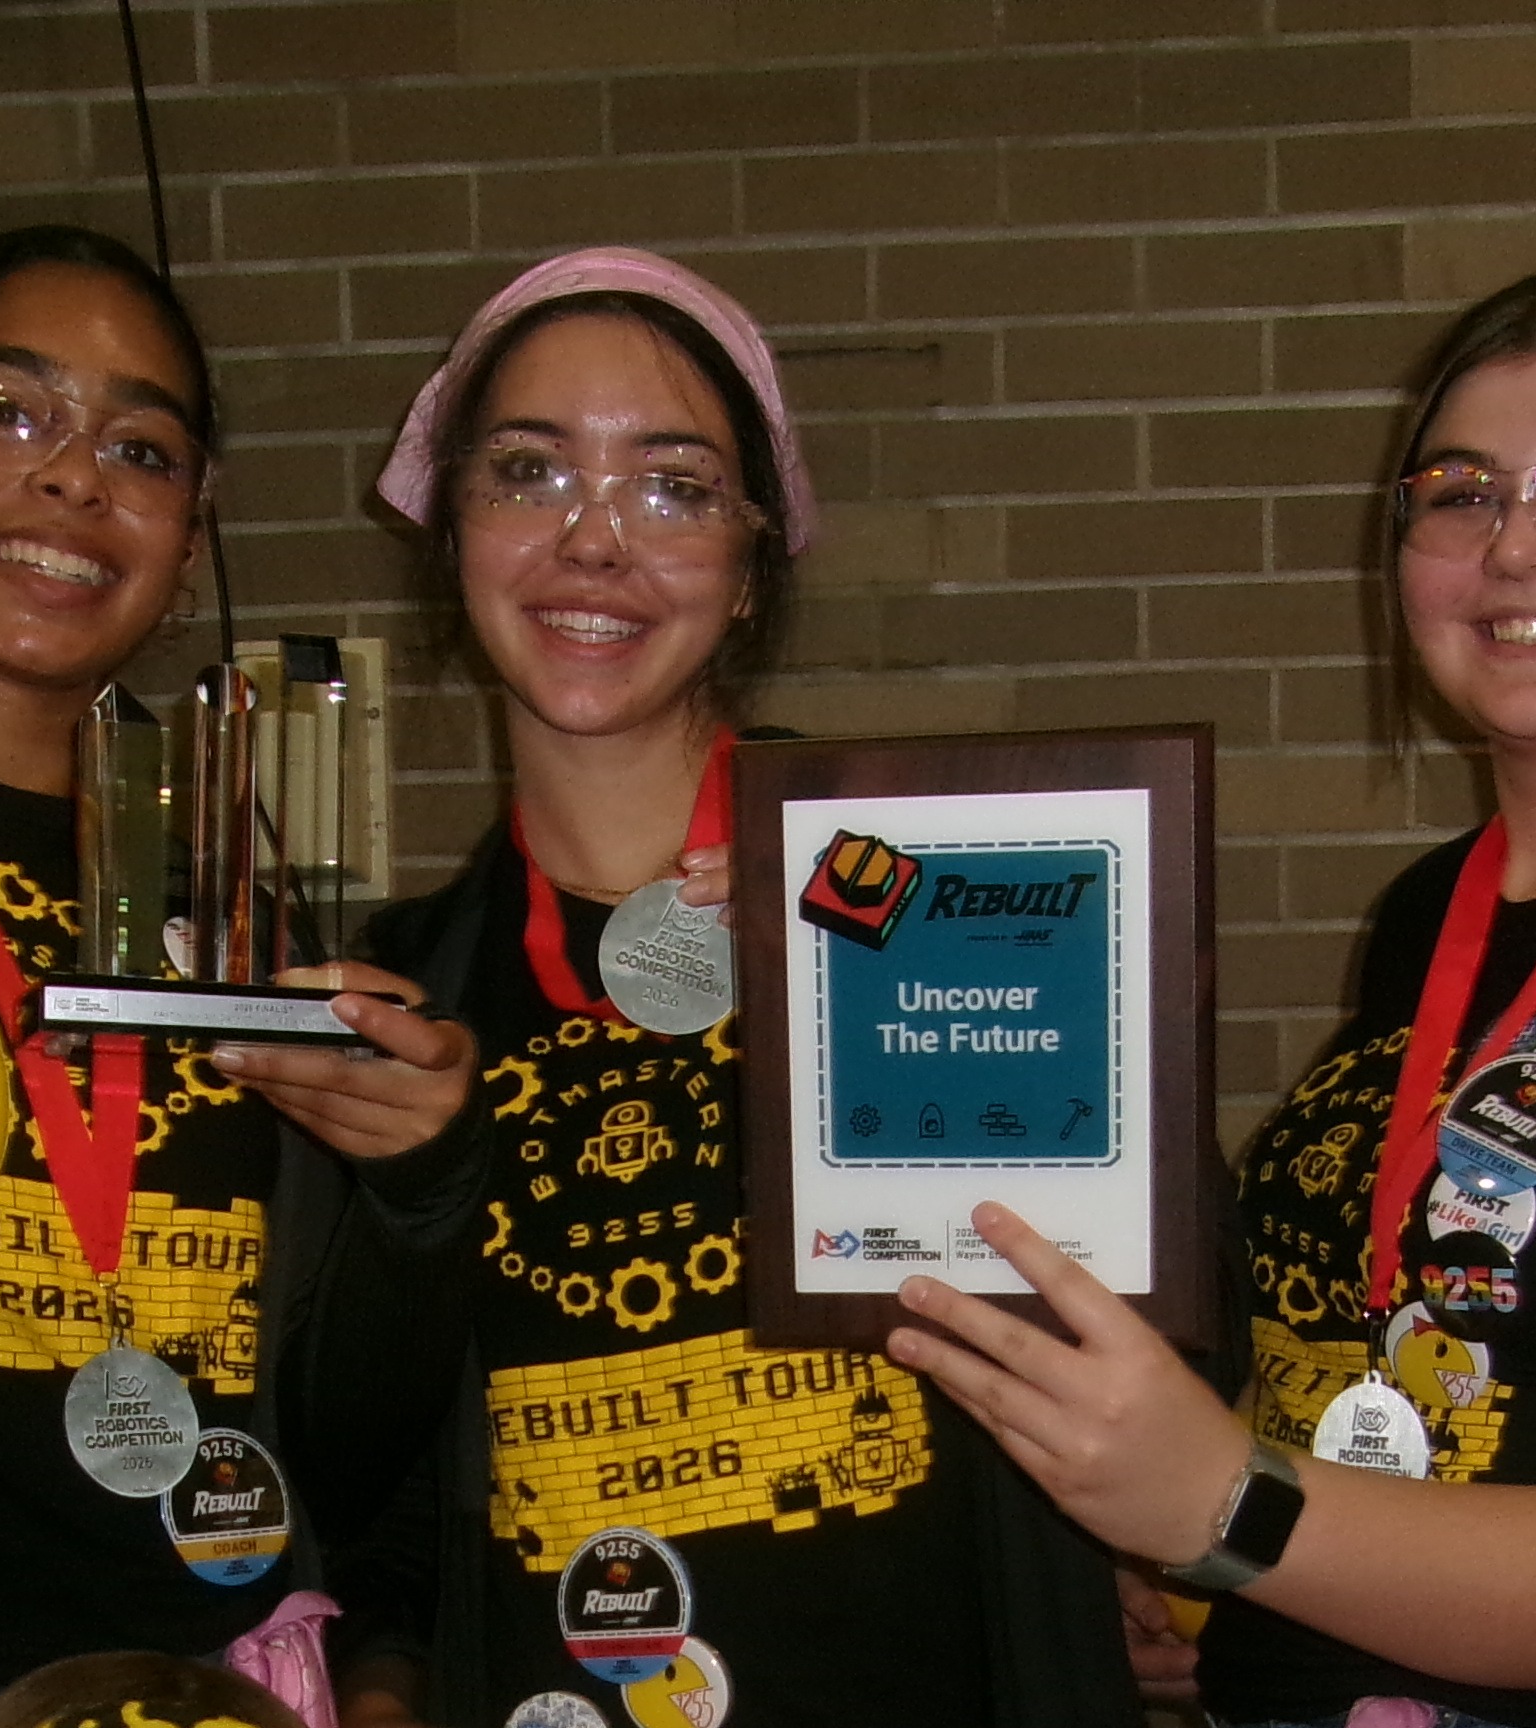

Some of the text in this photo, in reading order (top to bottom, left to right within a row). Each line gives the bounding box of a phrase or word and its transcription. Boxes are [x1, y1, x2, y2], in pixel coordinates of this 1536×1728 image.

[925, 873, 1097, 921] REBUILT
[655, 930, 706, 955] FIRST
[634, 939, 716, 977] ROBOTICS
[615, 951, 726, 998] COMPETITION
[642, 985, 680, 1008] 2026
[898, 980, 1038, 1012] Uncover
[877, 1022, 1061, 1054] The Future
[1451, 1137, 1484, 1162] DRIVE
[1485, 1152, 1518, 1176] TEAM
[1454, 1189, 1511, 1217] FIRST
[568, 1201, 696, 1248] 9255
[863, 1227, 898, 1238] FIRST
[1427, 1199, 1526, 1247] #LikeAGirl
[863, 1239, 921, 1250] ROBOTICS
[863, 1250, 942, 1261] COMPETITION
[955, 1251, 986, 1263] Wayne
[1419, 1264, 1518, 1314] 9255
[108, 1402, 151, 1417] FIRST
[492, 1350, 876, 1446] EBUILT TOUR
[95, 1416, 168, 1434] ROBOTICS
[85, 1431, 184, 1449] COMPETITION
[200, 1440, 245, 1462] 9255
[1351, 1435, 1390, 1451] FIRST
[121, 1456, 154, 1471] 2026
[596, 1438, 743, 1500] 2026
[1338, 1448, 1401, 1468] ROBOTICS
[192, 1487, 266, 1518] REBUILT
[213, 1541, 257, 1556] COACH
[595, 1540, 642, 1562] 9255
[582, 1587, 660, 1616] REBUILT
